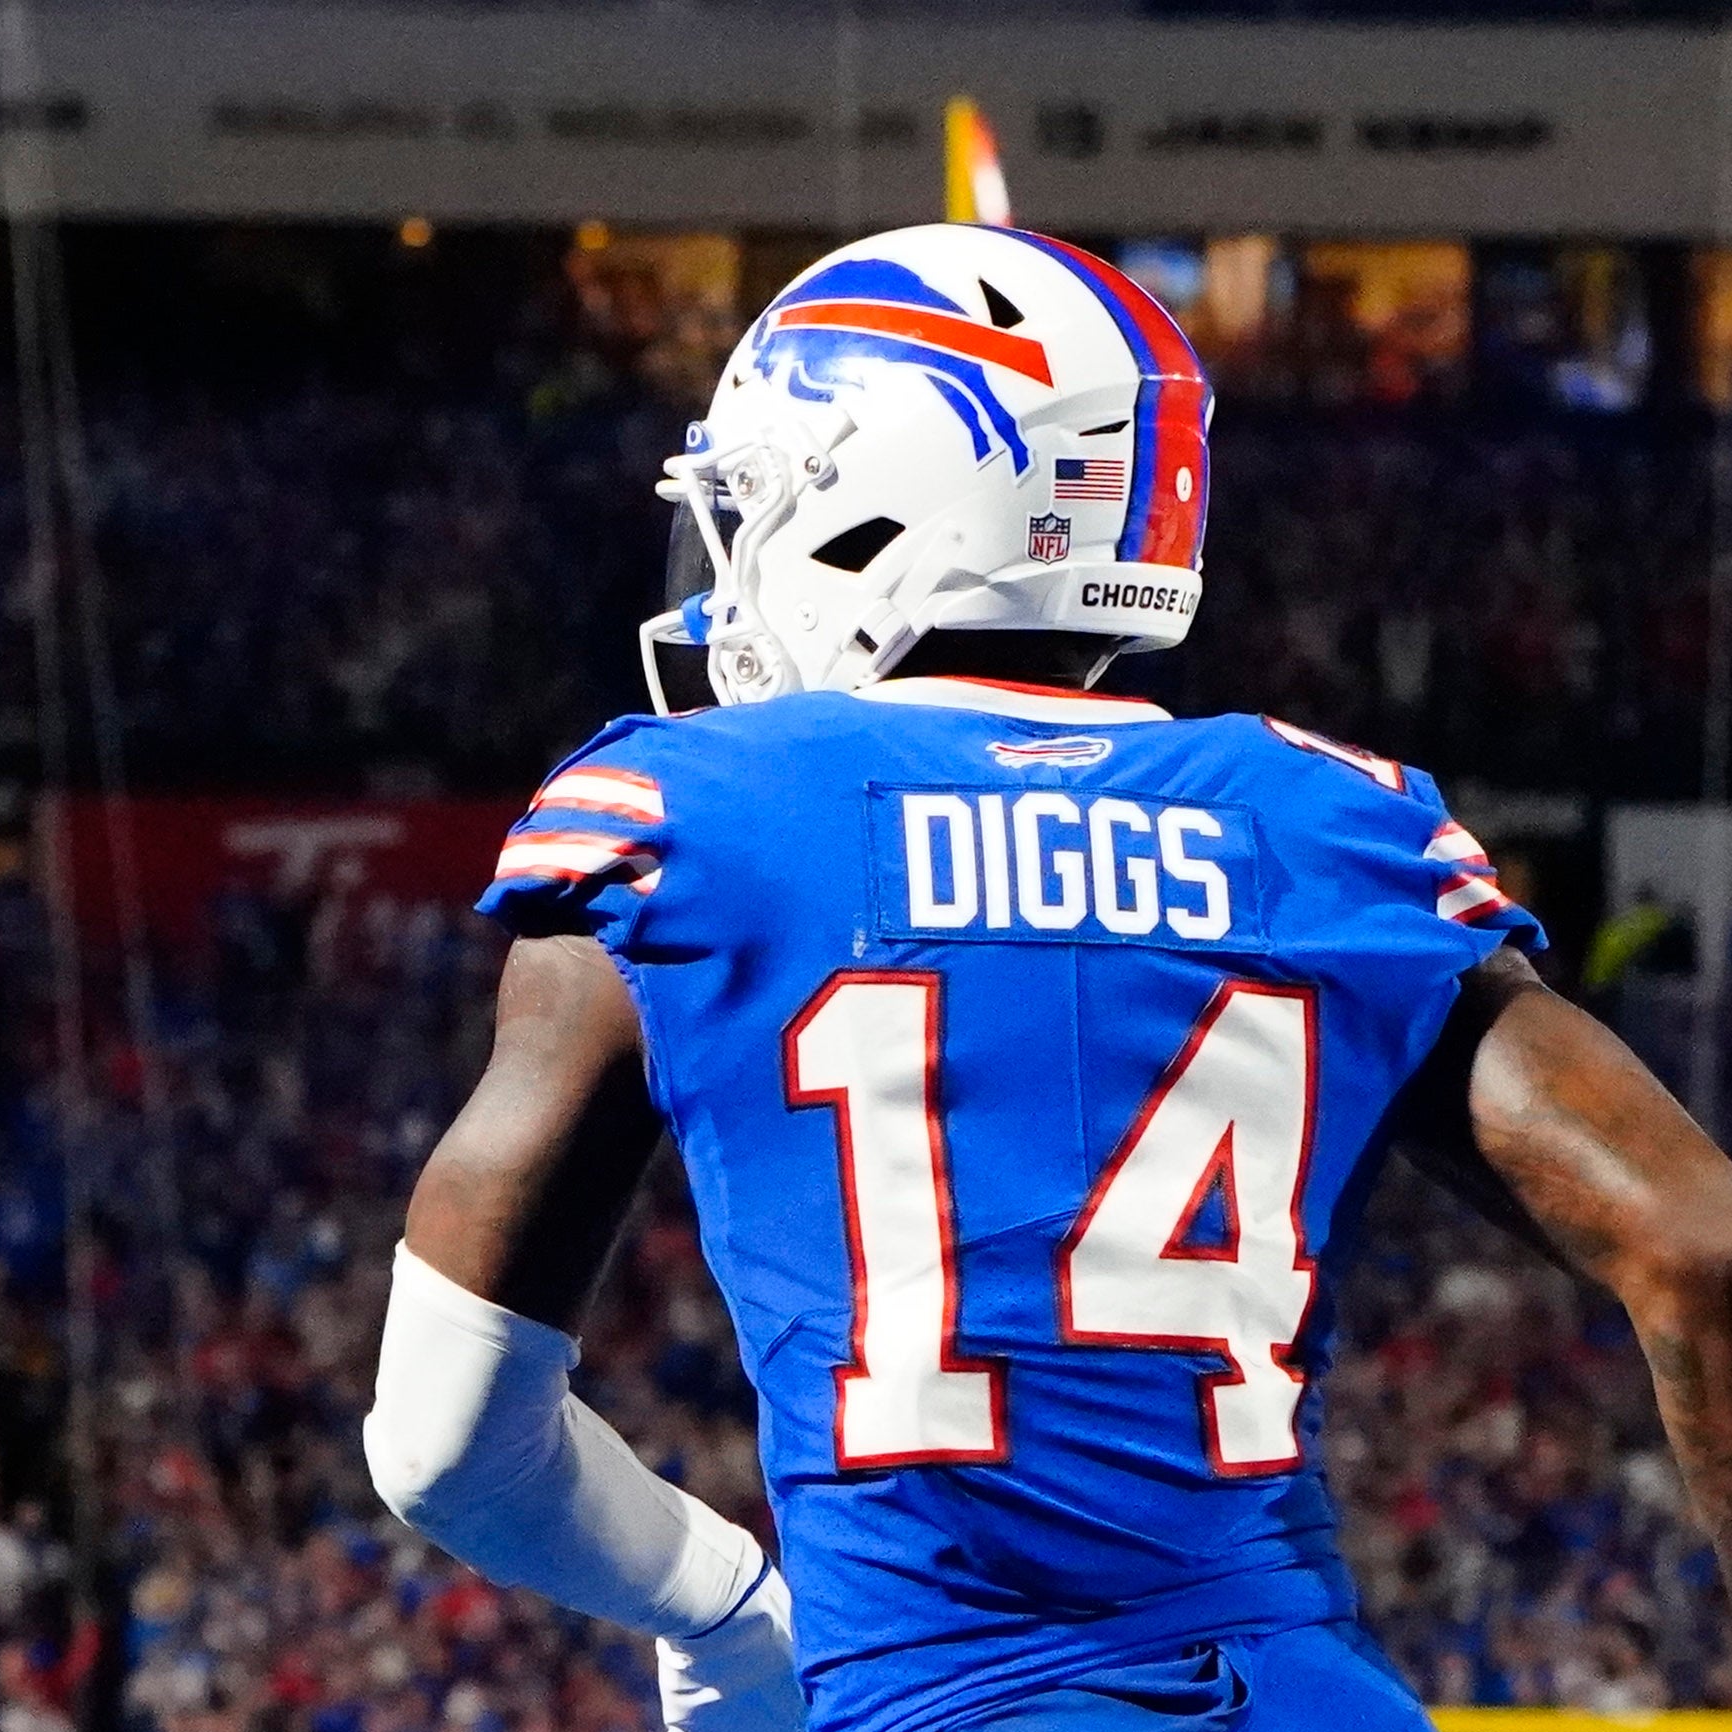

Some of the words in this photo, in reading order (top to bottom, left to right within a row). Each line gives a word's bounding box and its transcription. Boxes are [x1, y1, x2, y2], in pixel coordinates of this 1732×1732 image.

[1032, 535, 1066, 560] NFL
[1082, 583, 1179, 612] CHOOSE
[902, 792, 1232, 941] DIGGS
[780, 967, 1320, 1479] 14
